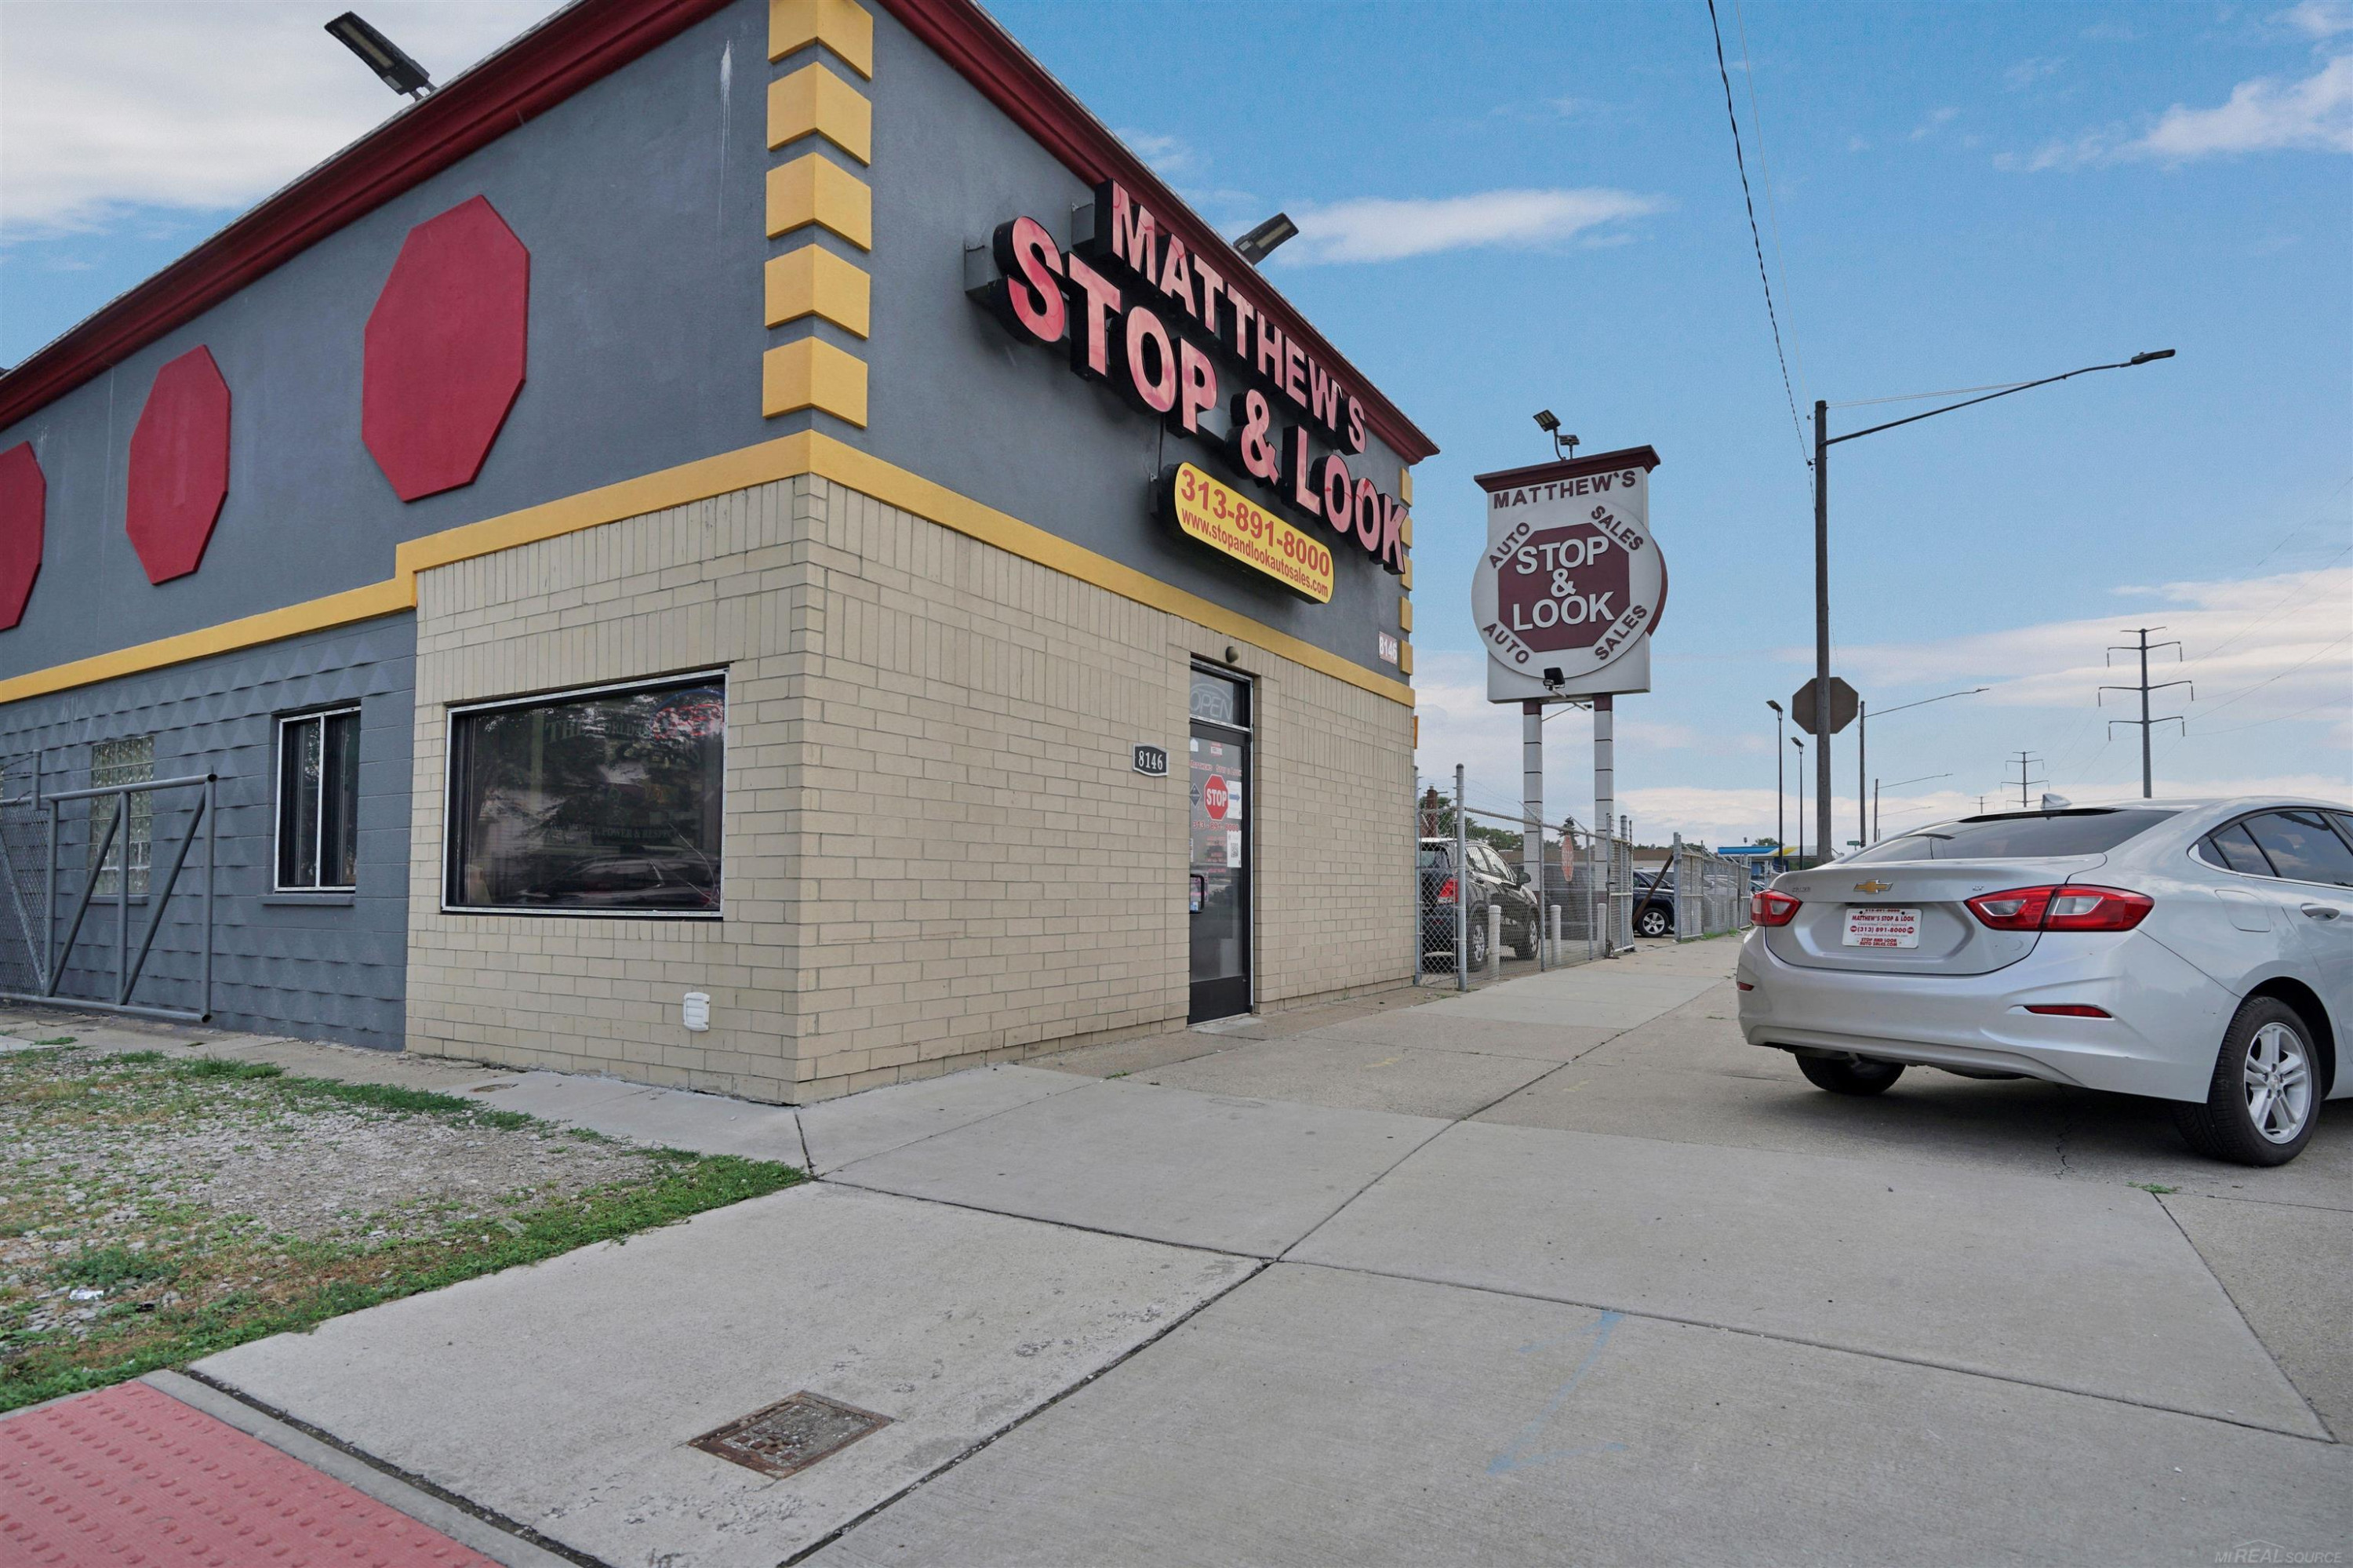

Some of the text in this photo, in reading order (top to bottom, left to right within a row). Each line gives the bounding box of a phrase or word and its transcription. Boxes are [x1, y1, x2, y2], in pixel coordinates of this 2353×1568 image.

[1112, 179, 1366, 453] MATTHEW'S
[1008, 216, 1408, 575] STOP & LOOK
[1493, 470, 1635, 509] MATTHEW'S
[1180, 469, 1329, 577] 313-891-8000
[1489, 505, 1644, 569] AUTO SALES
[1181, 508, 1329, 598] www.stopandlookautosales.com
[1515, 535, 1610, 576] STOP
[1550, 567, 1577, 598] &
[1512, 591, 1615, 631] LOOK
[1379, 636, 1397, 661] 8146
[1482, 604, 1647, 664] AUTO SALES
[1190, 690, 1233, 720] OPEN
[1138, 751, 1163, 770] 8146
[1206, 788, 1227, 806] STOP
